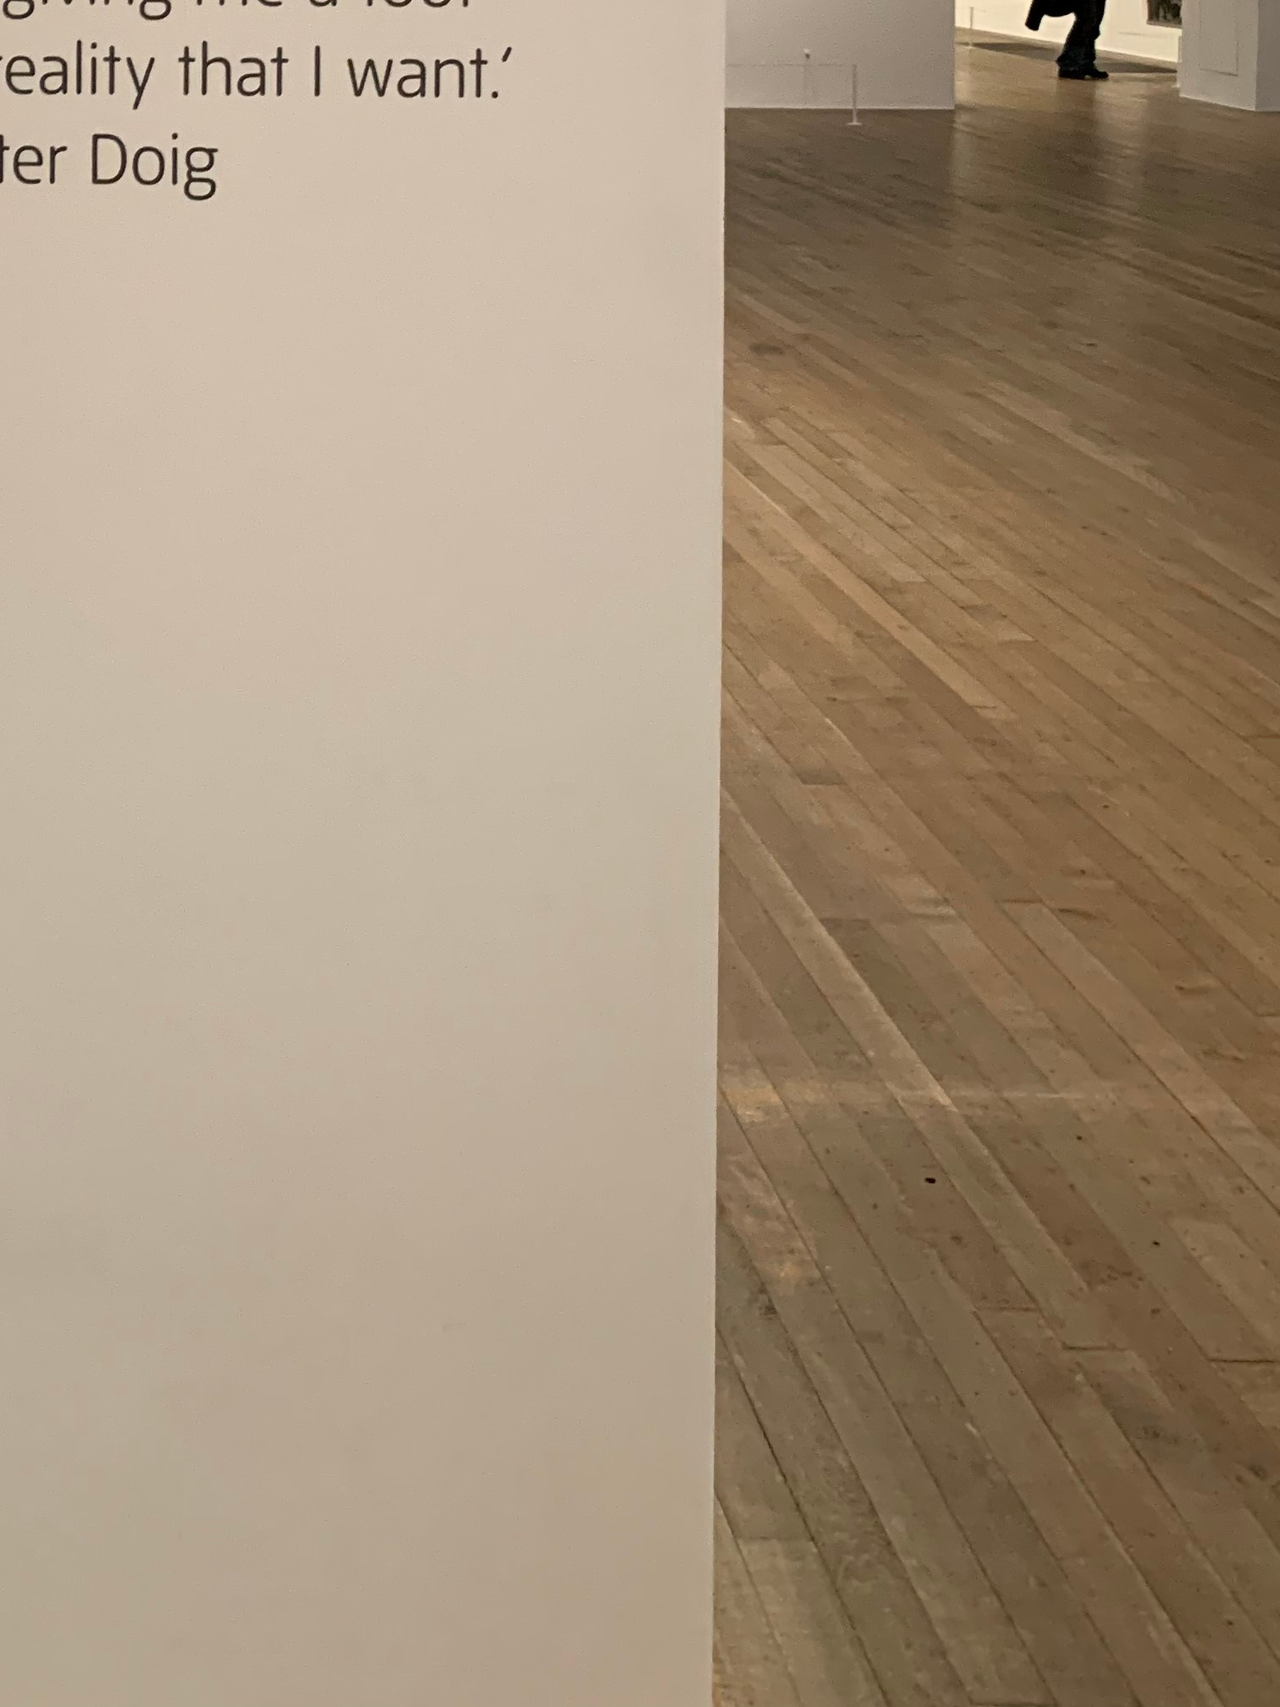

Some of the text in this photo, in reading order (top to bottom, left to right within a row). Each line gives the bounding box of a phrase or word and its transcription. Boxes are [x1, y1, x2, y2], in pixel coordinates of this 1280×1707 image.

[177, 39, 290, 98] that
[313, 44, 322, 98] I
[91, 132, 219, 202] Doig
